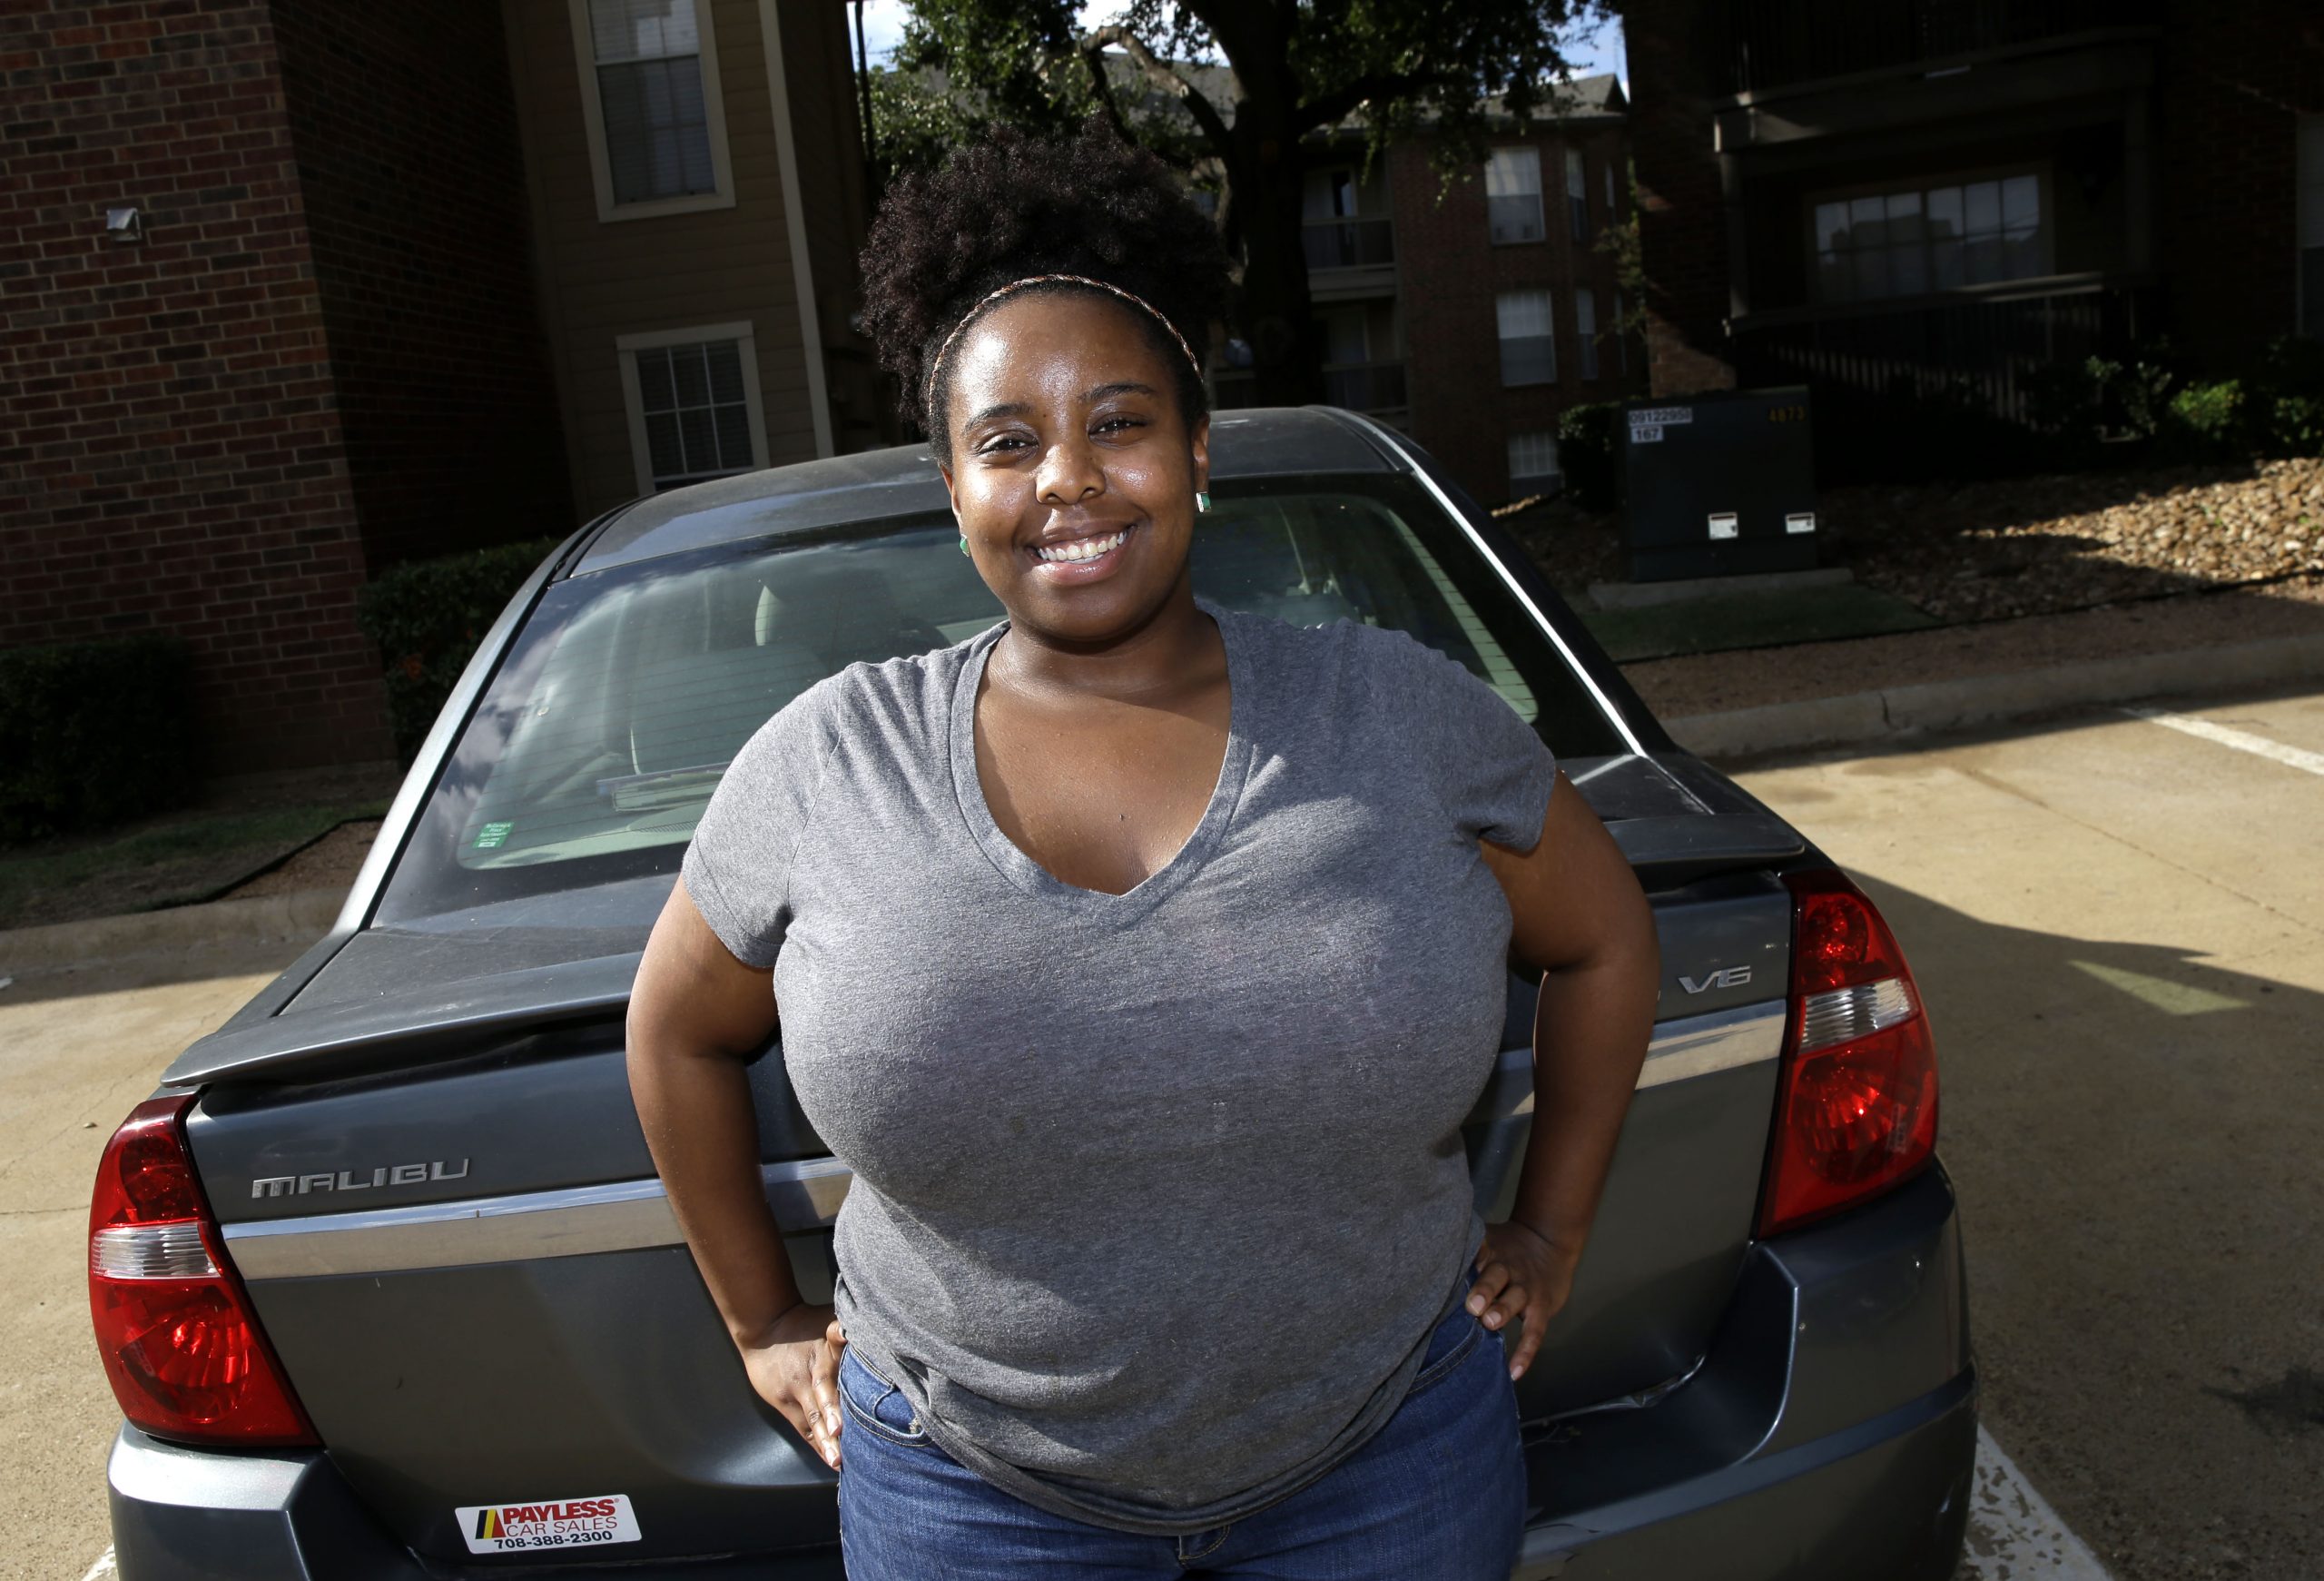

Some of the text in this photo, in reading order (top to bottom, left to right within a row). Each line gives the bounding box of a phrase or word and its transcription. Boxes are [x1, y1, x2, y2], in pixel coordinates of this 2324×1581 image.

[1636, 427, 1659, 441] 167
[1677, 964, 1751, 994] V6
[251, 1157, 470, 1199] MALIBU
[502, 1498, 616, 1525] PAYLESS
[506, 1516, 618, 1537] CAR SALES
[494, 1530, 614, 1549] 708-388-2300
